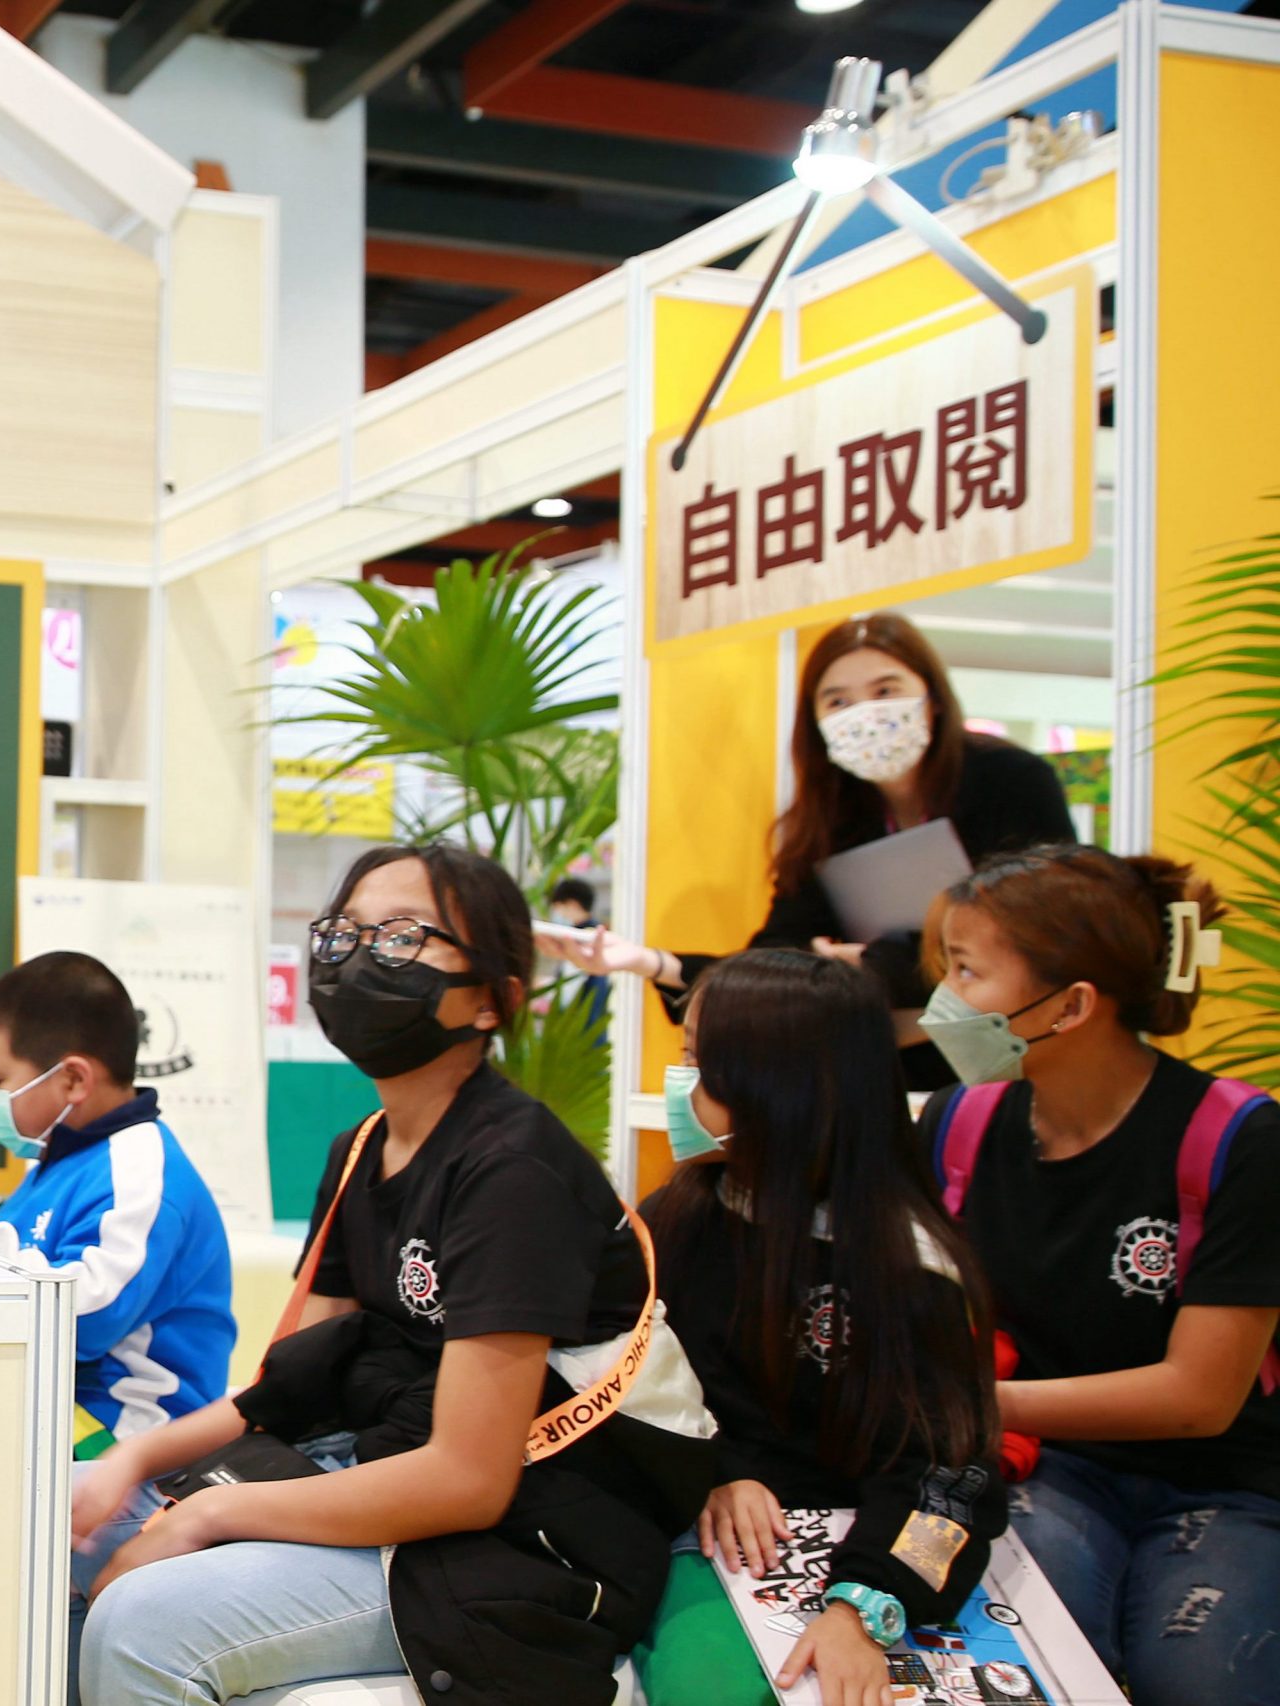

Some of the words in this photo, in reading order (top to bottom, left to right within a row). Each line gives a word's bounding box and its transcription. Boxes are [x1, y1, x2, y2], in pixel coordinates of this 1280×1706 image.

[681, 378, 1029, 600] 自由取閱
[540, 1373, 622, 1443] AMOUR
